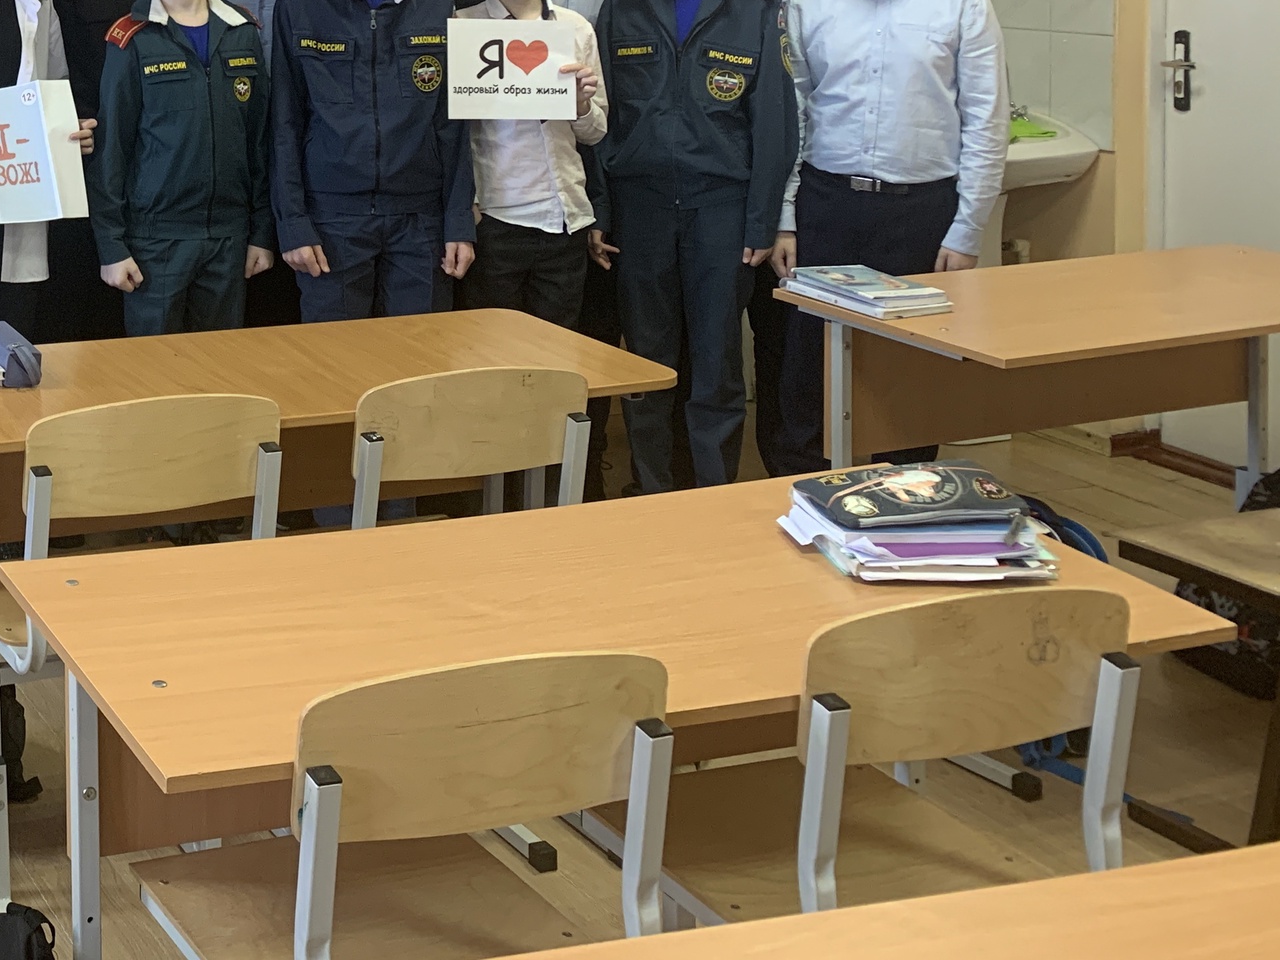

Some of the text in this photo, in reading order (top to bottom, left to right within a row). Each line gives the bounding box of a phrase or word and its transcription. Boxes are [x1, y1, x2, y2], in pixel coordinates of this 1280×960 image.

[300, 39, 345, 52] МЧС РОССИИ
[476, 39, 504, 79] Я
[709, 50, 753, 65] МЧС РОССИИ
[144, 61, 187, 75] МЧС РОССИИ
[21, 92, 36, 102] 12+
[453, 84, 568, 97] здоровый образ жизни
